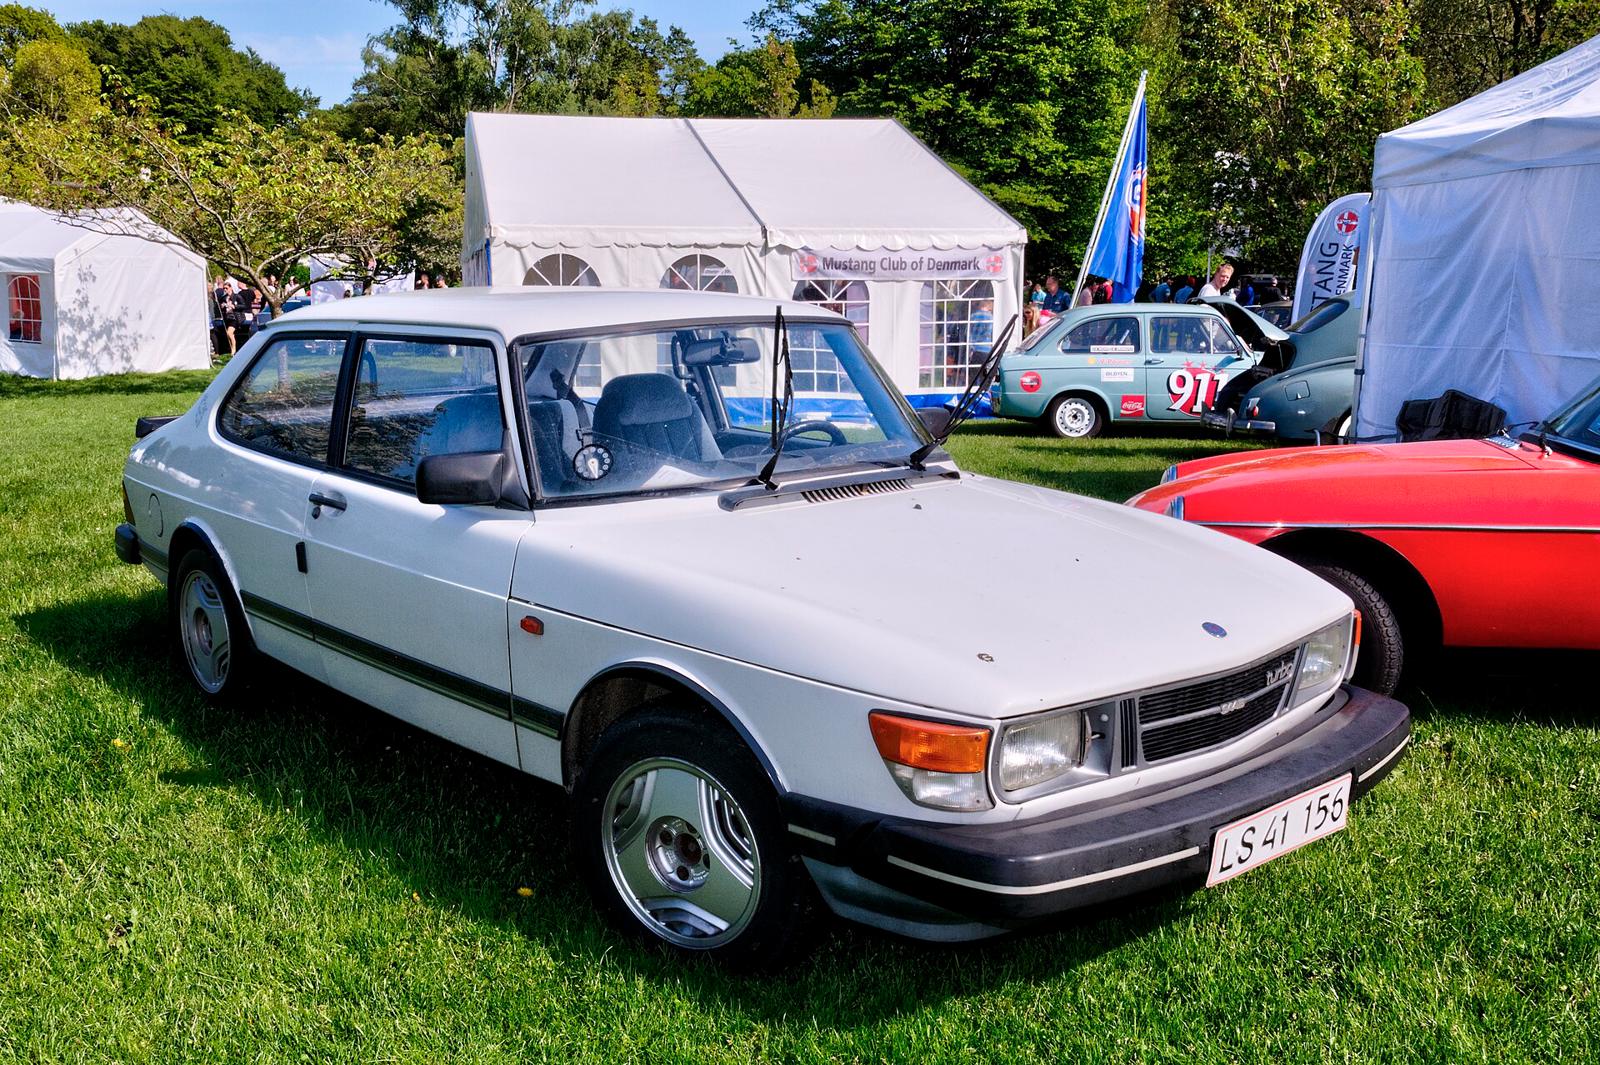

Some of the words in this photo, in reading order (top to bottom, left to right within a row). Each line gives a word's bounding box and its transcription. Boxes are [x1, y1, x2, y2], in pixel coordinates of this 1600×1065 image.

[823, 257, 876, 273] Mustang
[880, 257, 907, 271] Club
[911, 257, 924, 271] of
[927, 256, 980, 271] Denmark
[1219, 826, 1256, 873] LS
[1262, 810, 1289, 849] 41
[1305, 786, 1343, 834] 156
